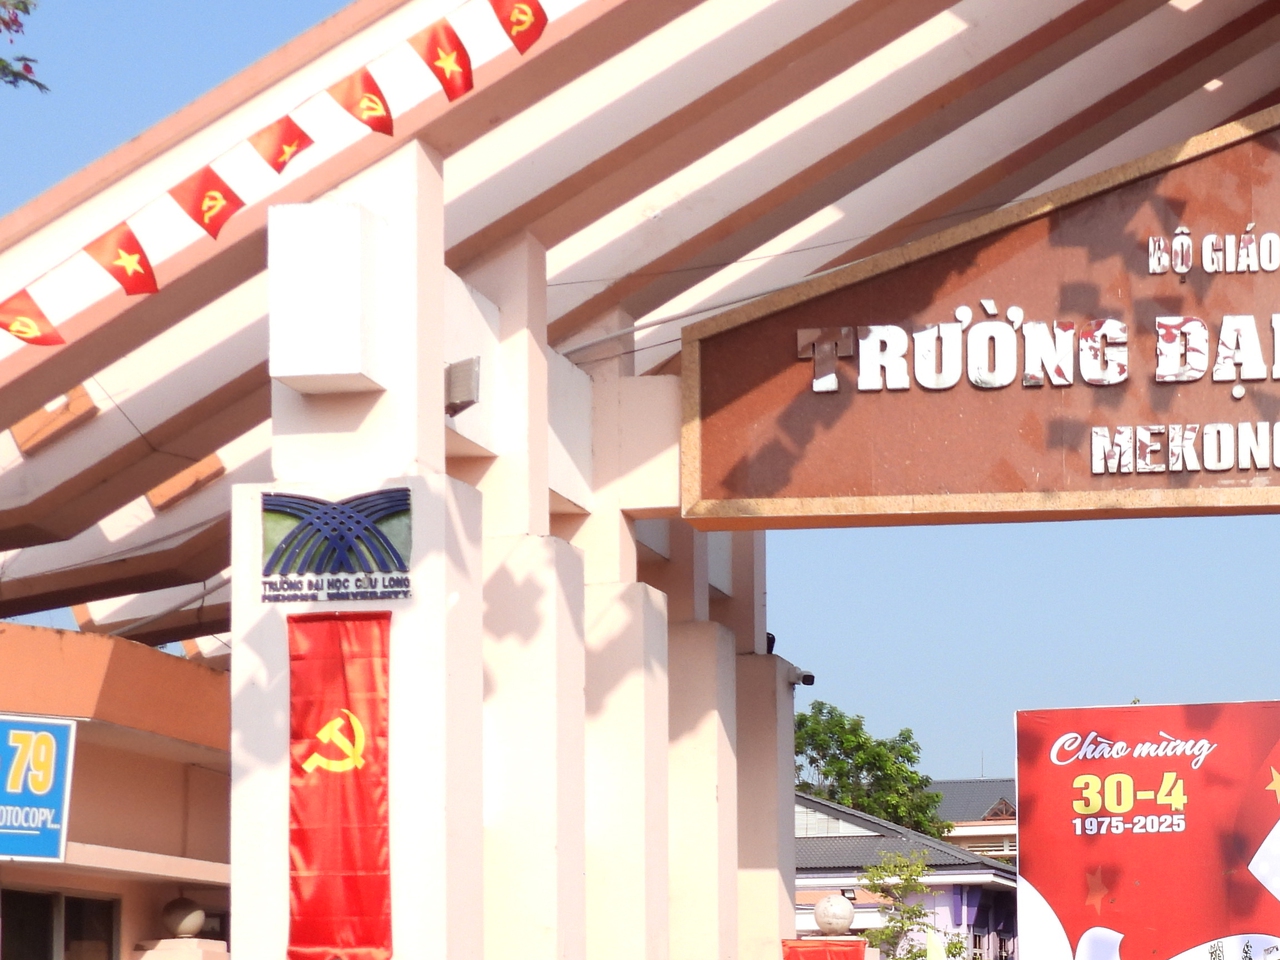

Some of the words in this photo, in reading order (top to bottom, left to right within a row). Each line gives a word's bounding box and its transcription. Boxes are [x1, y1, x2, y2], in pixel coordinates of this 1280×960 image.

[1148, 227, 1194, 282] BỘ
[1201, 223, 1280, 275] GIÁO
[797, 299, 1130, 394] TRƯỜNG
[382, 576, 410, 590] LONG
[6, 729, 57, 795] 79
[1050, 731, 1131, 766] Chào
[1132, 730, 1218, 770] mừng
[1071, 771, 1188, 815] 30-4
[1071, 814, 1186, 836] 1975-2025
